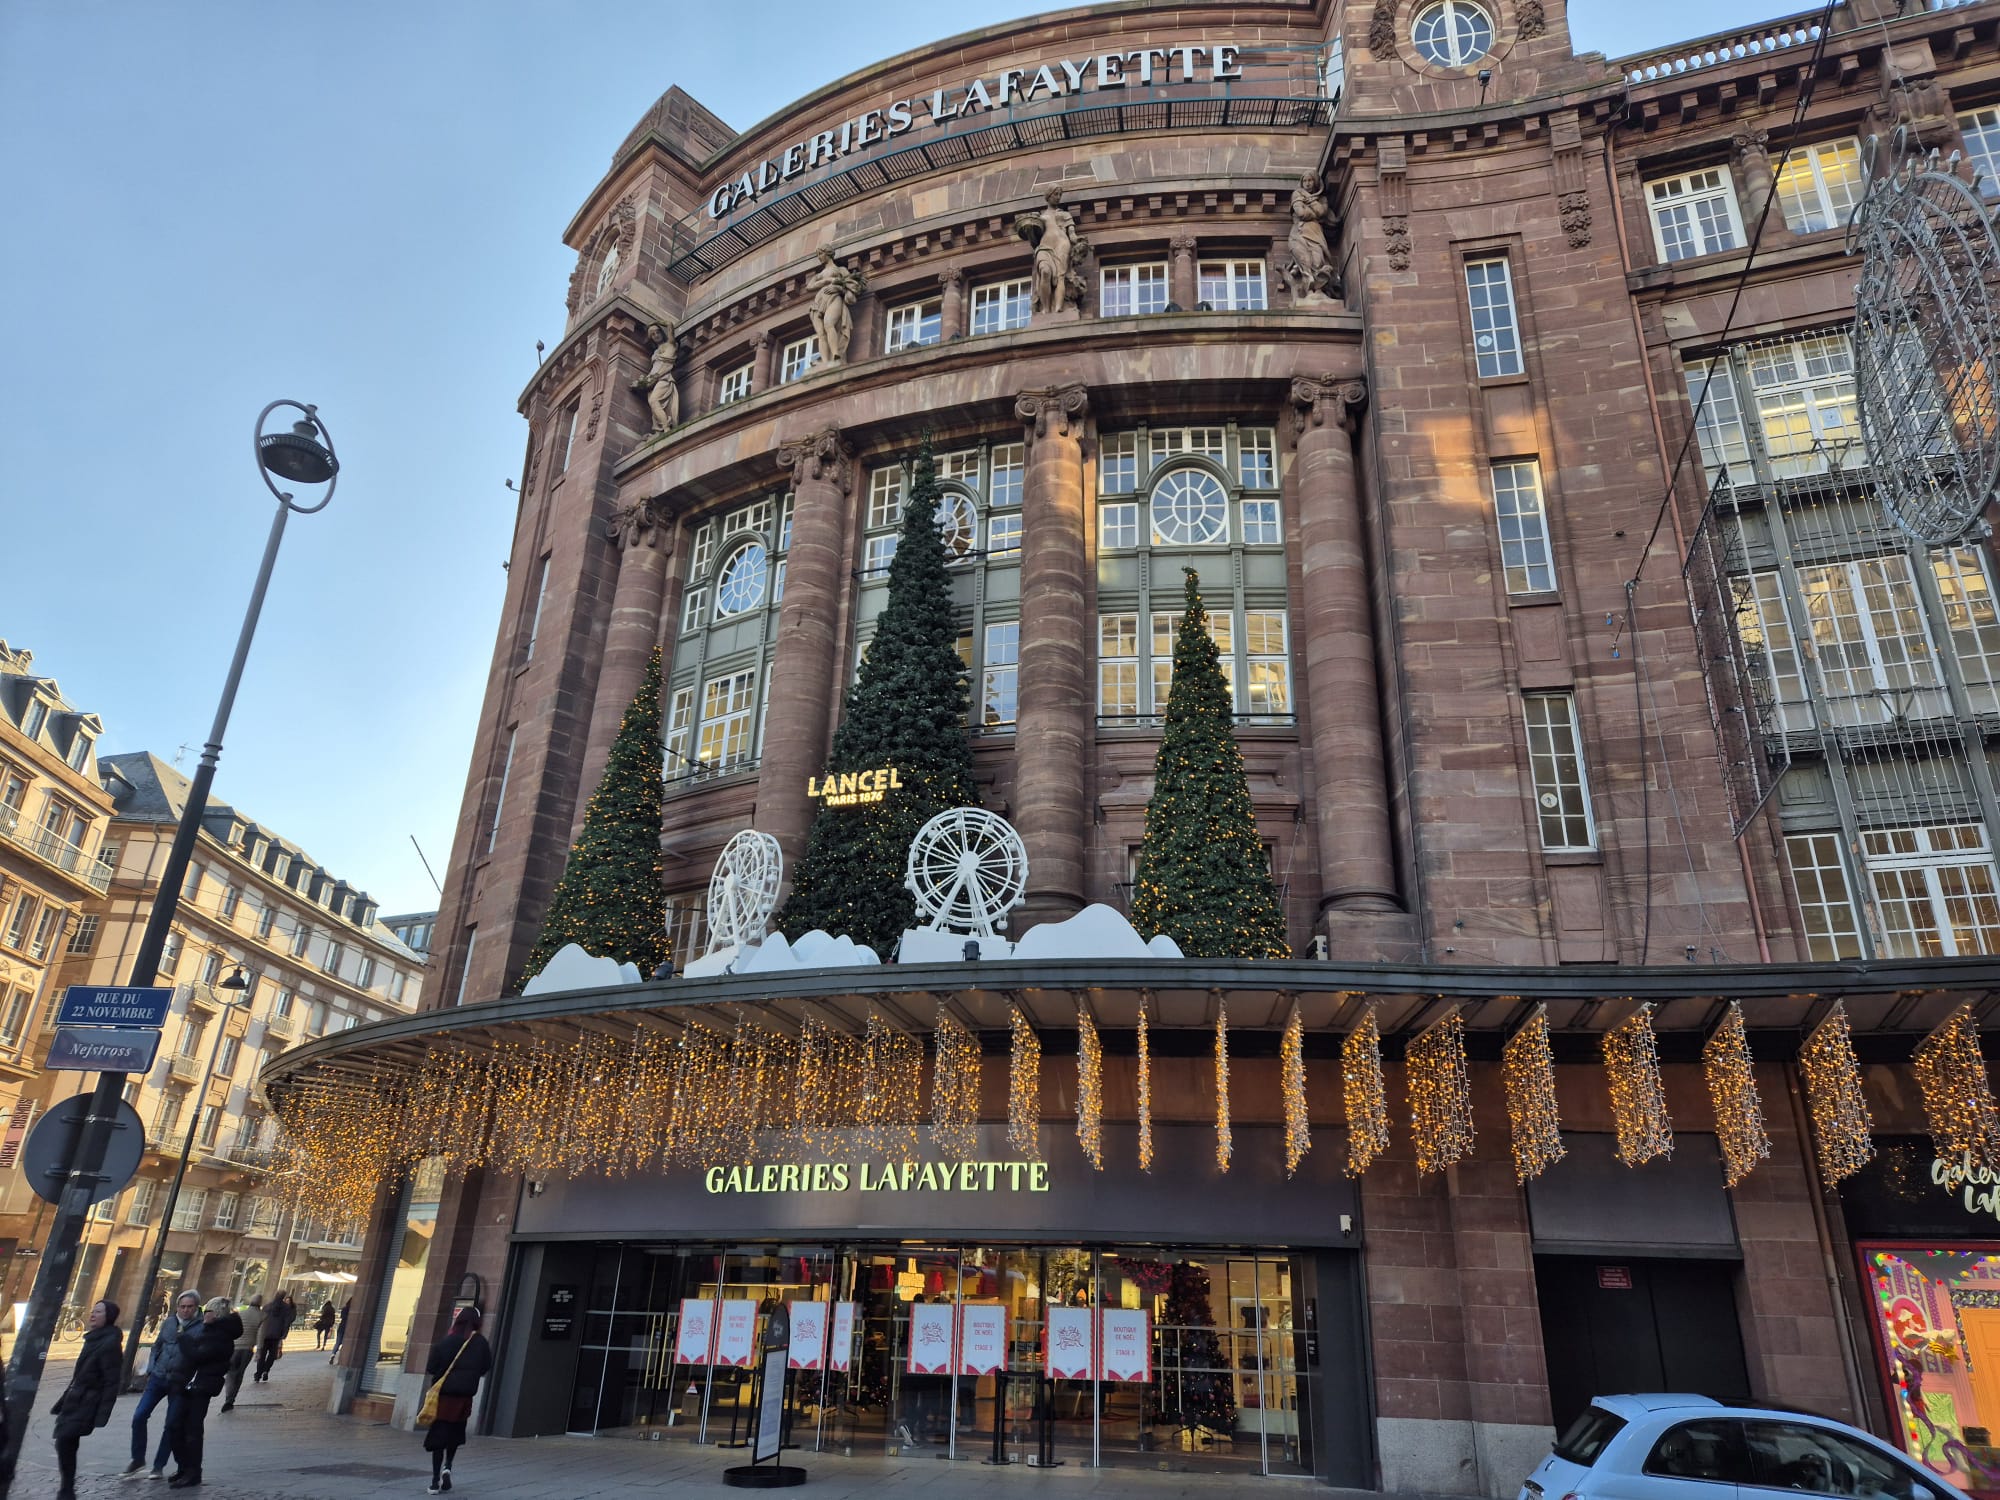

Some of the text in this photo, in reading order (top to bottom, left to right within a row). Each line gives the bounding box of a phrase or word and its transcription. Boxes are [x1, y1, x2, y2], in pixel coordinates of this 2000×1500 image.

[707, 45, 1243, 219] GALERIES LAFAYETTE
[807, 767, 903, 797] LANCEL
[826, 791, 885, 806] PARIS 1876
[94, 992, 142, 1005] RUE DU
[71, 1005, 156, 1020] 22 NOVEMBRE
[68, 1042, 132, 1059] Nejstross
[10, 1098, 34, 1129] COSMOS
[705, 1161, 1050, 1194] GALERIES LAFAYETTE
